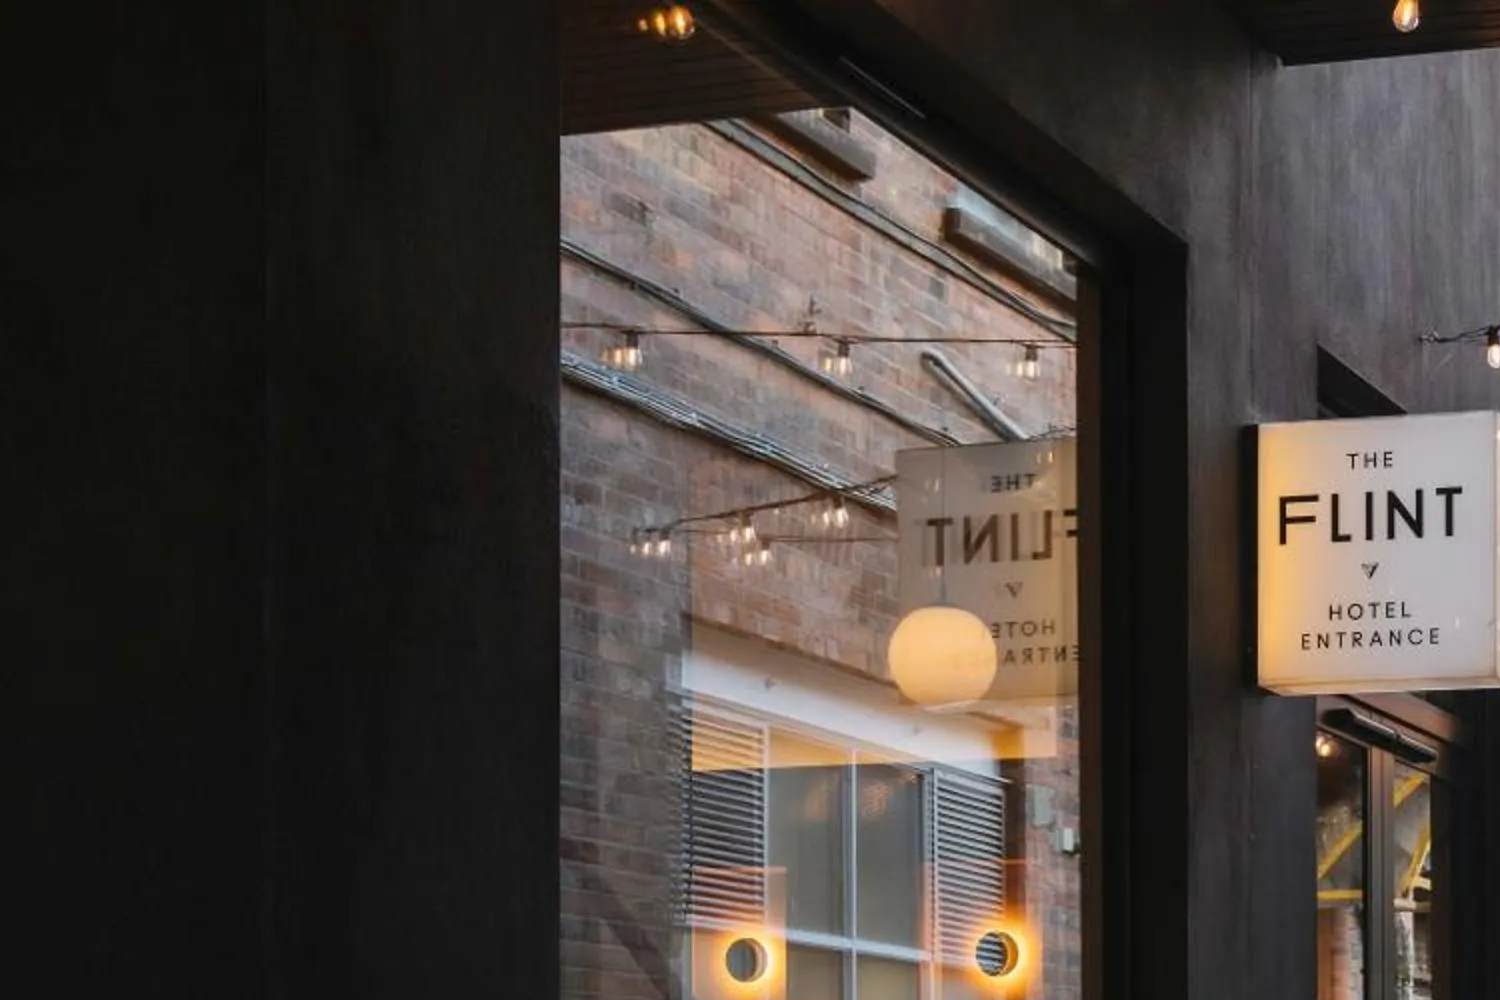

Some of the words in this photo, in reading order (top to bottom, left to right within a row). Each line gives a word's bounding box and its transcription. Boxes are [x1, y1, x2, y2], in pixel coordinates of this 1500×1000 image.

[1346, 451, 1394, 470] THE
[1279, 486, 1463, 546] FLINT
[1329, 601, 1412, 621] HOTEL
[1301, 627, 1441, 650] ENTRANCE
